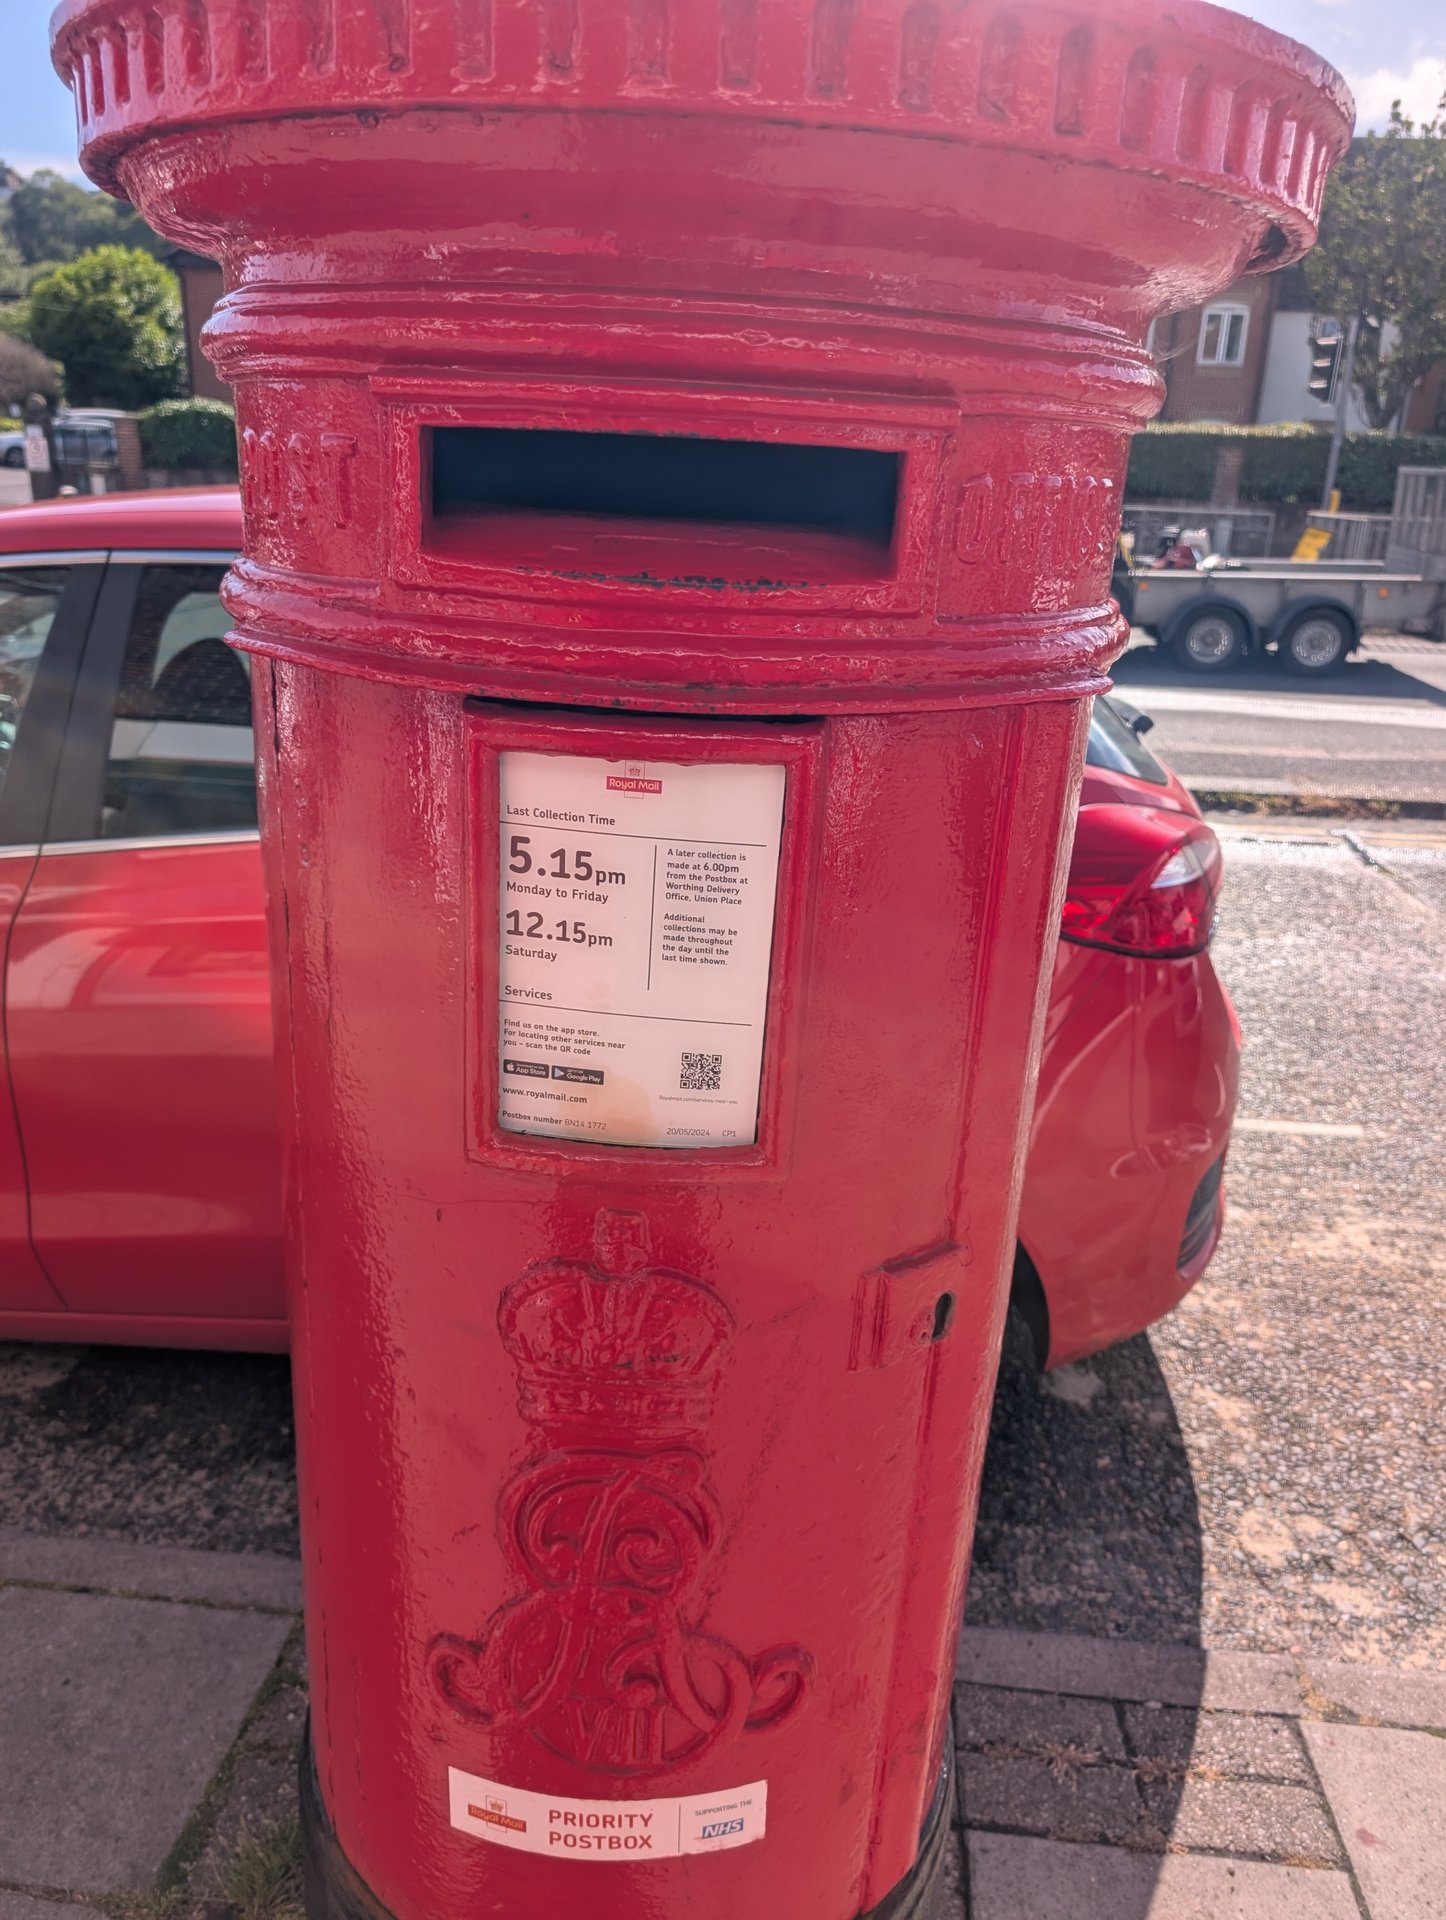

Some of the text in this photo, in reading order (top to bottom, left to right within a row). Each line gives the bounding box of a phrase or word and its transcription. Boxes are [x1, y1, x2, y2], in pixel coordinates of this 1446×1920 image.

[610, 778, 660, 790] Royal Mail
[506, 805, 616, 826] Last Collection Time
[668, 848, 674, 856] A
[676, 849, 695, 858] later
[698, 851, 736, 860] collection
[509, 836, 626, 886] 5.15pm
[704, 862, 739, 874] 6.00pm
[666, 871, 686, 880] from
[689, 873, 702, 881] the
[705, 874, 737, 883] Postbox
[506, 881, 608, 904] Monday to Friday
[666, 882, 740, 895] Worthing Delivery
[666, 892, 742, 905] Office, Union Place
[664, 913, 705, 923] Additional
[506, 910, 613, 948] 12.15pm
[664, 924, 738, 936] collections may be
[663, 934, 733, 946] made throughout
[505, 945, 557, 961] Saturday
[662, 944, 675, 952] the
[678, 945, 692, 954] day
[695, 946, 713, 954] until
[679, 955, 697, 963] time
[700, 957, 727, 966] shown.
[504, 985, 552, 1000] Services
[504, 1019, 520, 1027] Find
[504, 1028, 626, 1049] For locating other services near
[573, 1047, 591, 1055] code
[530, 1068, 546, 1076] Store
[567, 1073, 588, 1081] Google
[502, 1087, 587, 1103] www.royalmail.com
[502, 1110, 606, 1130] Postbox number BN14 1772
[666, 1128, 710, 1136] 20/05/2024
[695, 1799, 752, 1816] SUPPORTING THE
[471, 1806, 523, 1829] Royal Mail
[549, 1810, 653, 1829] PRIORITY
[704, 1820, 742, 1837] NHS
[550, 1832, 652, 1850] POSTBOX
